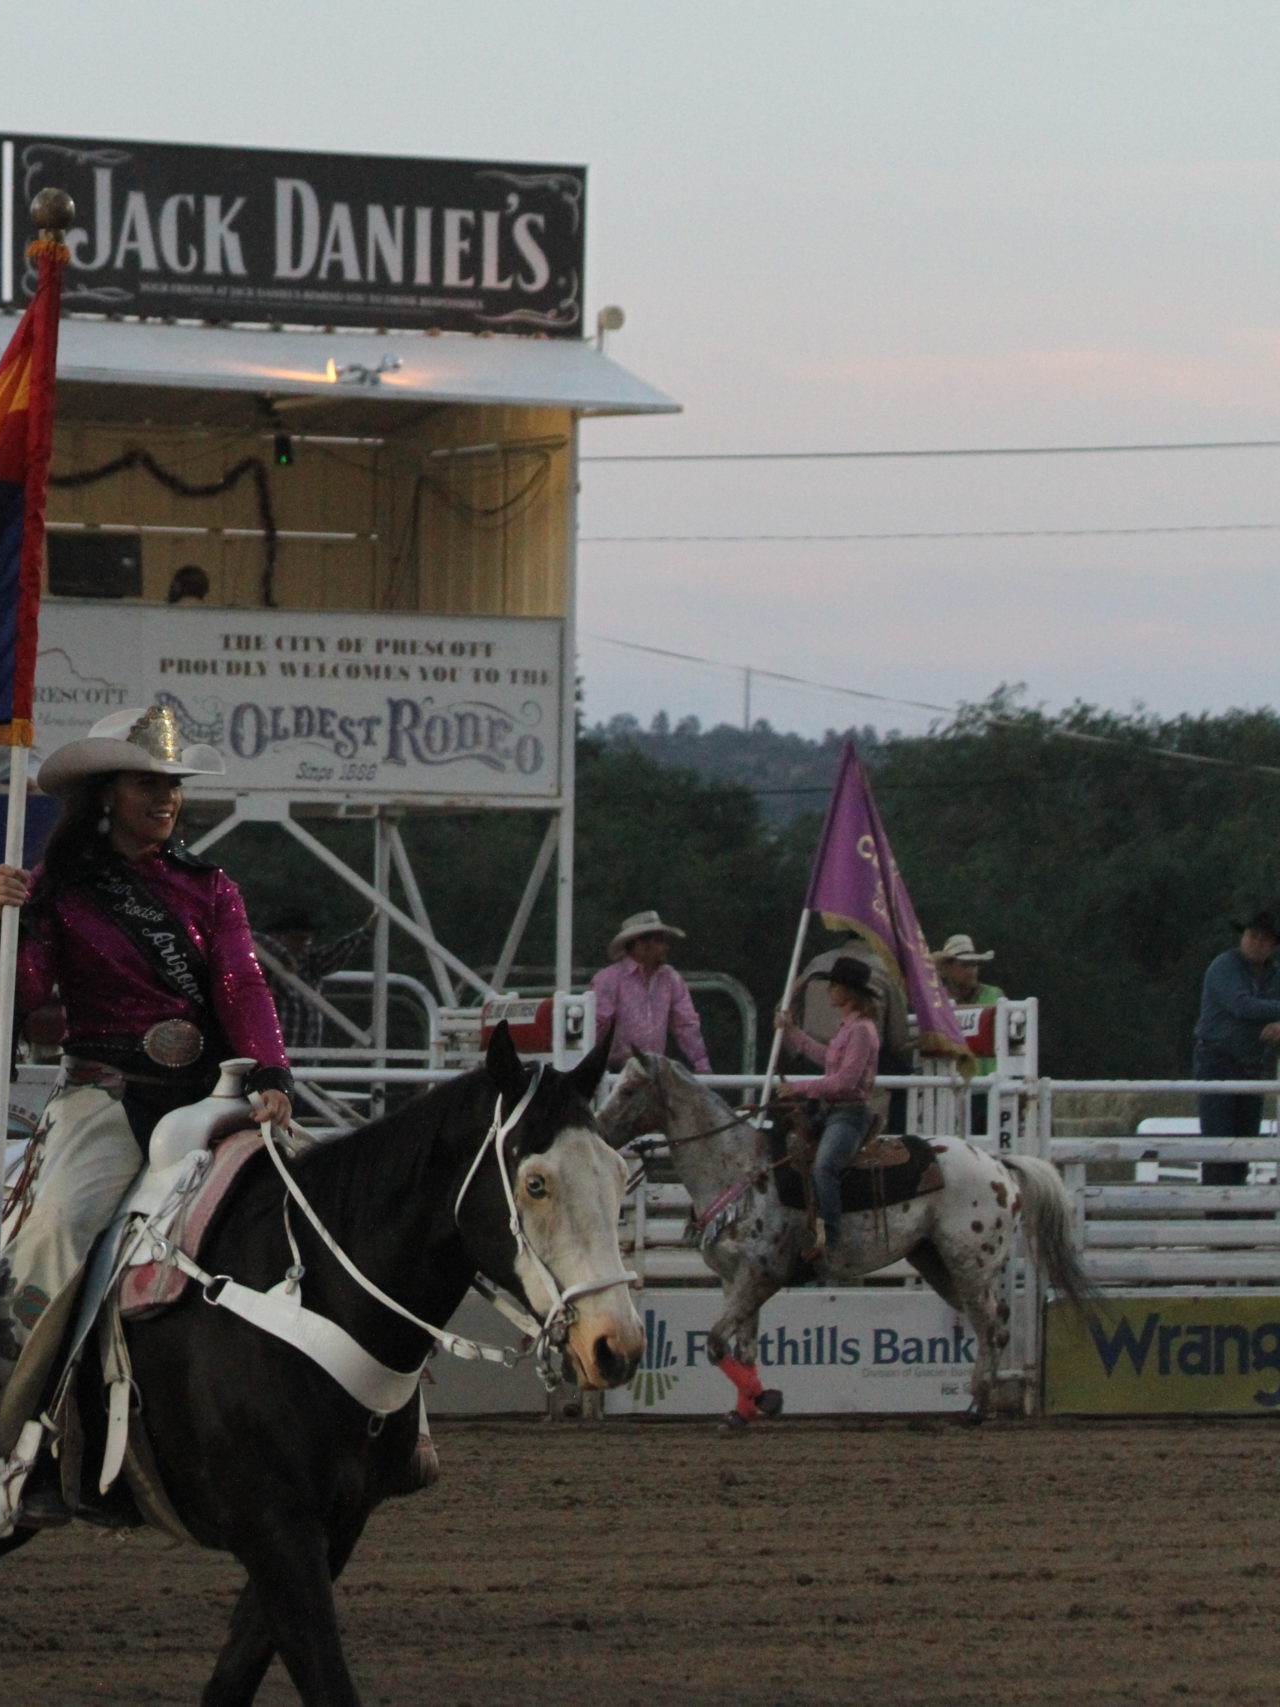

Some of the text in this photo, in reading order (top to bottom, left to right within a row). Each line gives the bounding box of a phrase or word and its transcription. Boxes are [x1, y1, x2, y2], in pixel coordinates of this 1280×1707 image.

[69, 167, 552, 293] JACK DANIEL'S
[221, 633, 497, 658] THE CITY OF PRESCOTT
[159, 657, 553, 687] PROUDLY WELCOMES YOU TO THE
[229, 701, 383, 759] OLDEST
[383, 697, 544, 775] RODEO
[685, 1325, 861, 1366] Fthills
[871, 1325, 976, 1364] Bank
